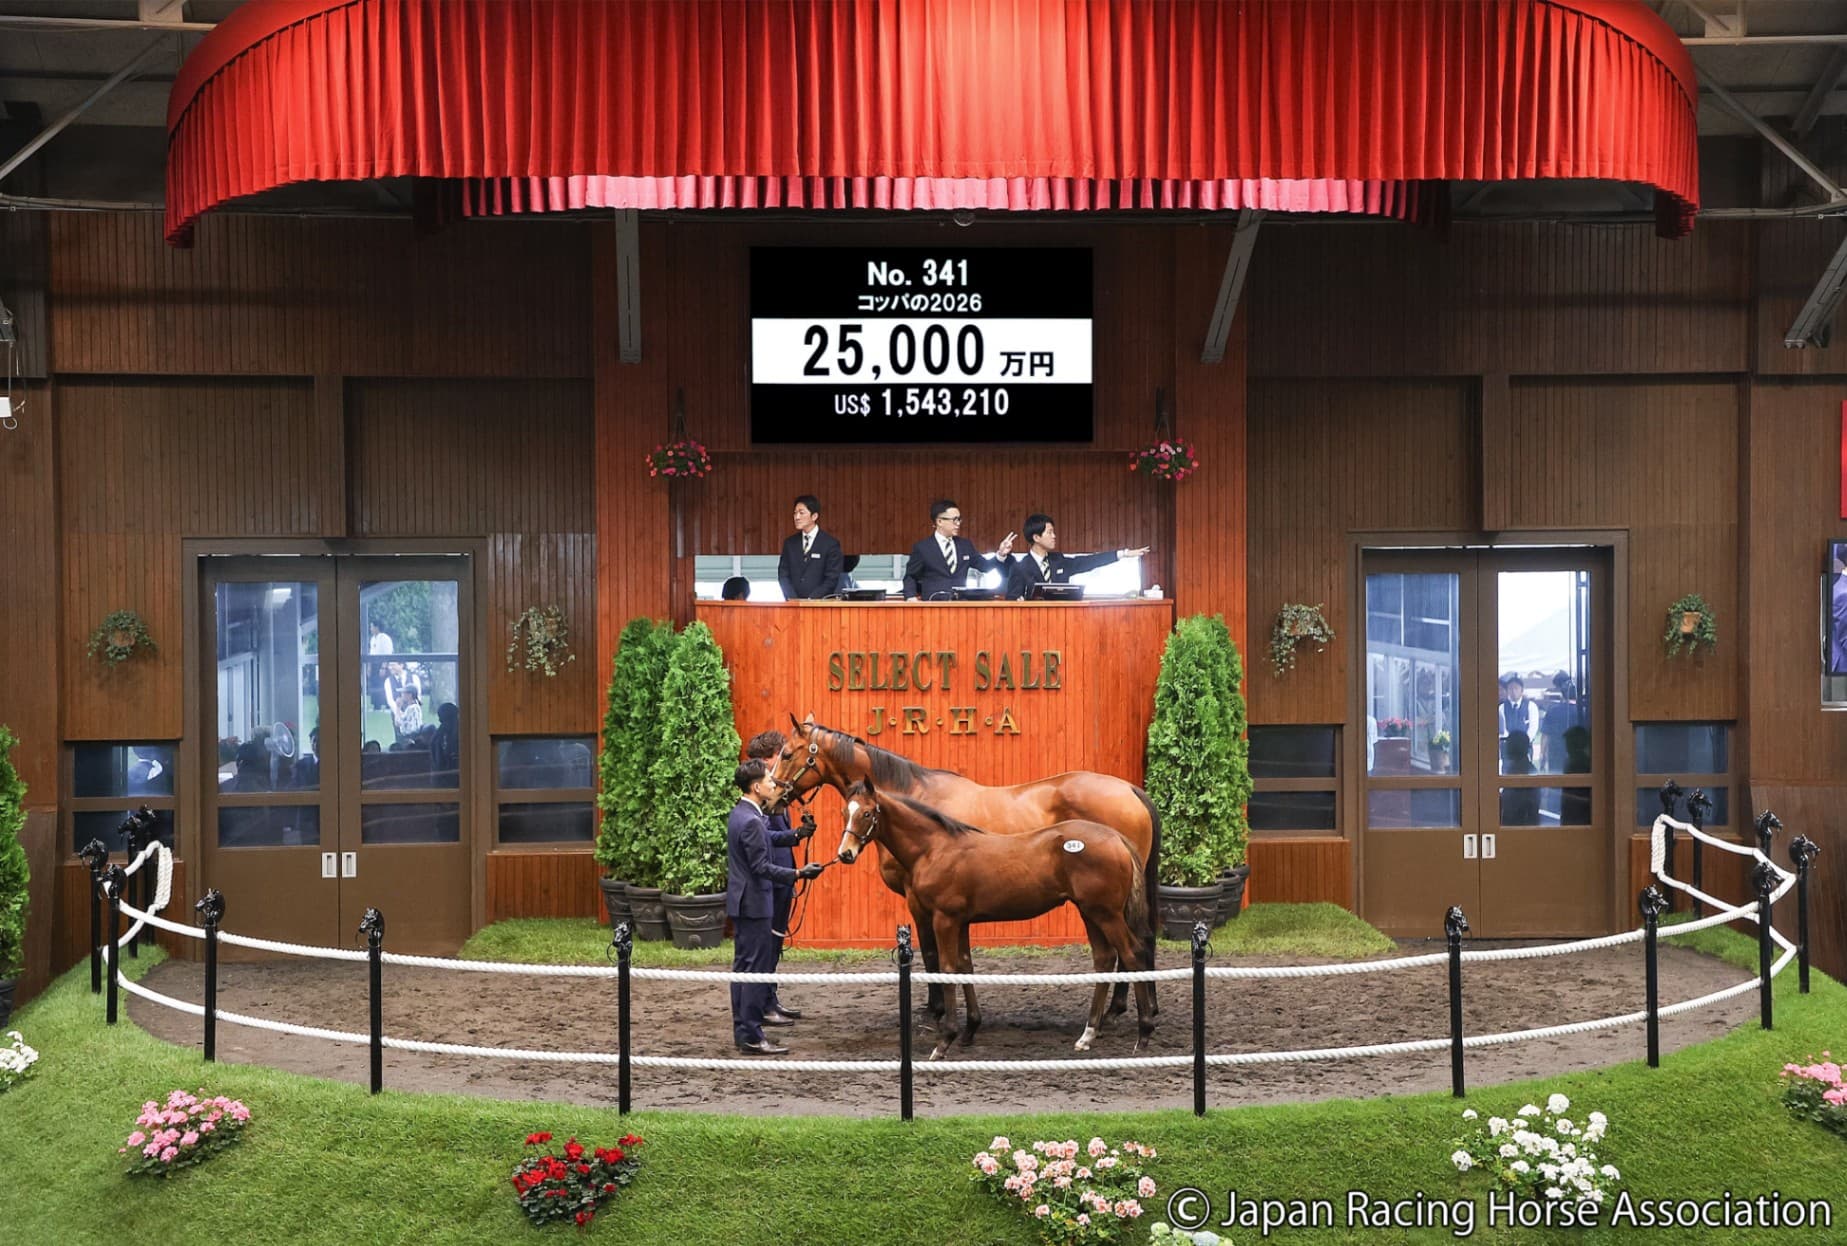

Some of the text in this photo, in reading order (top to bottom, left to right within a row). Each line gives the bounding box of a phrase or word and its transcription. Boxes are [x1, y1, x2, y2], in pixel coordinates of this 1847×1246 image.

[868, 259, 968, 286] No. 341
[858, 292, 982, 312] コッパの2026
[803, 323, 1055, 380] 25,000 万円
[834, 388, 1009, 418] US$ 1,543,210
[828, 651, 1062, 691] SELECT SALE
